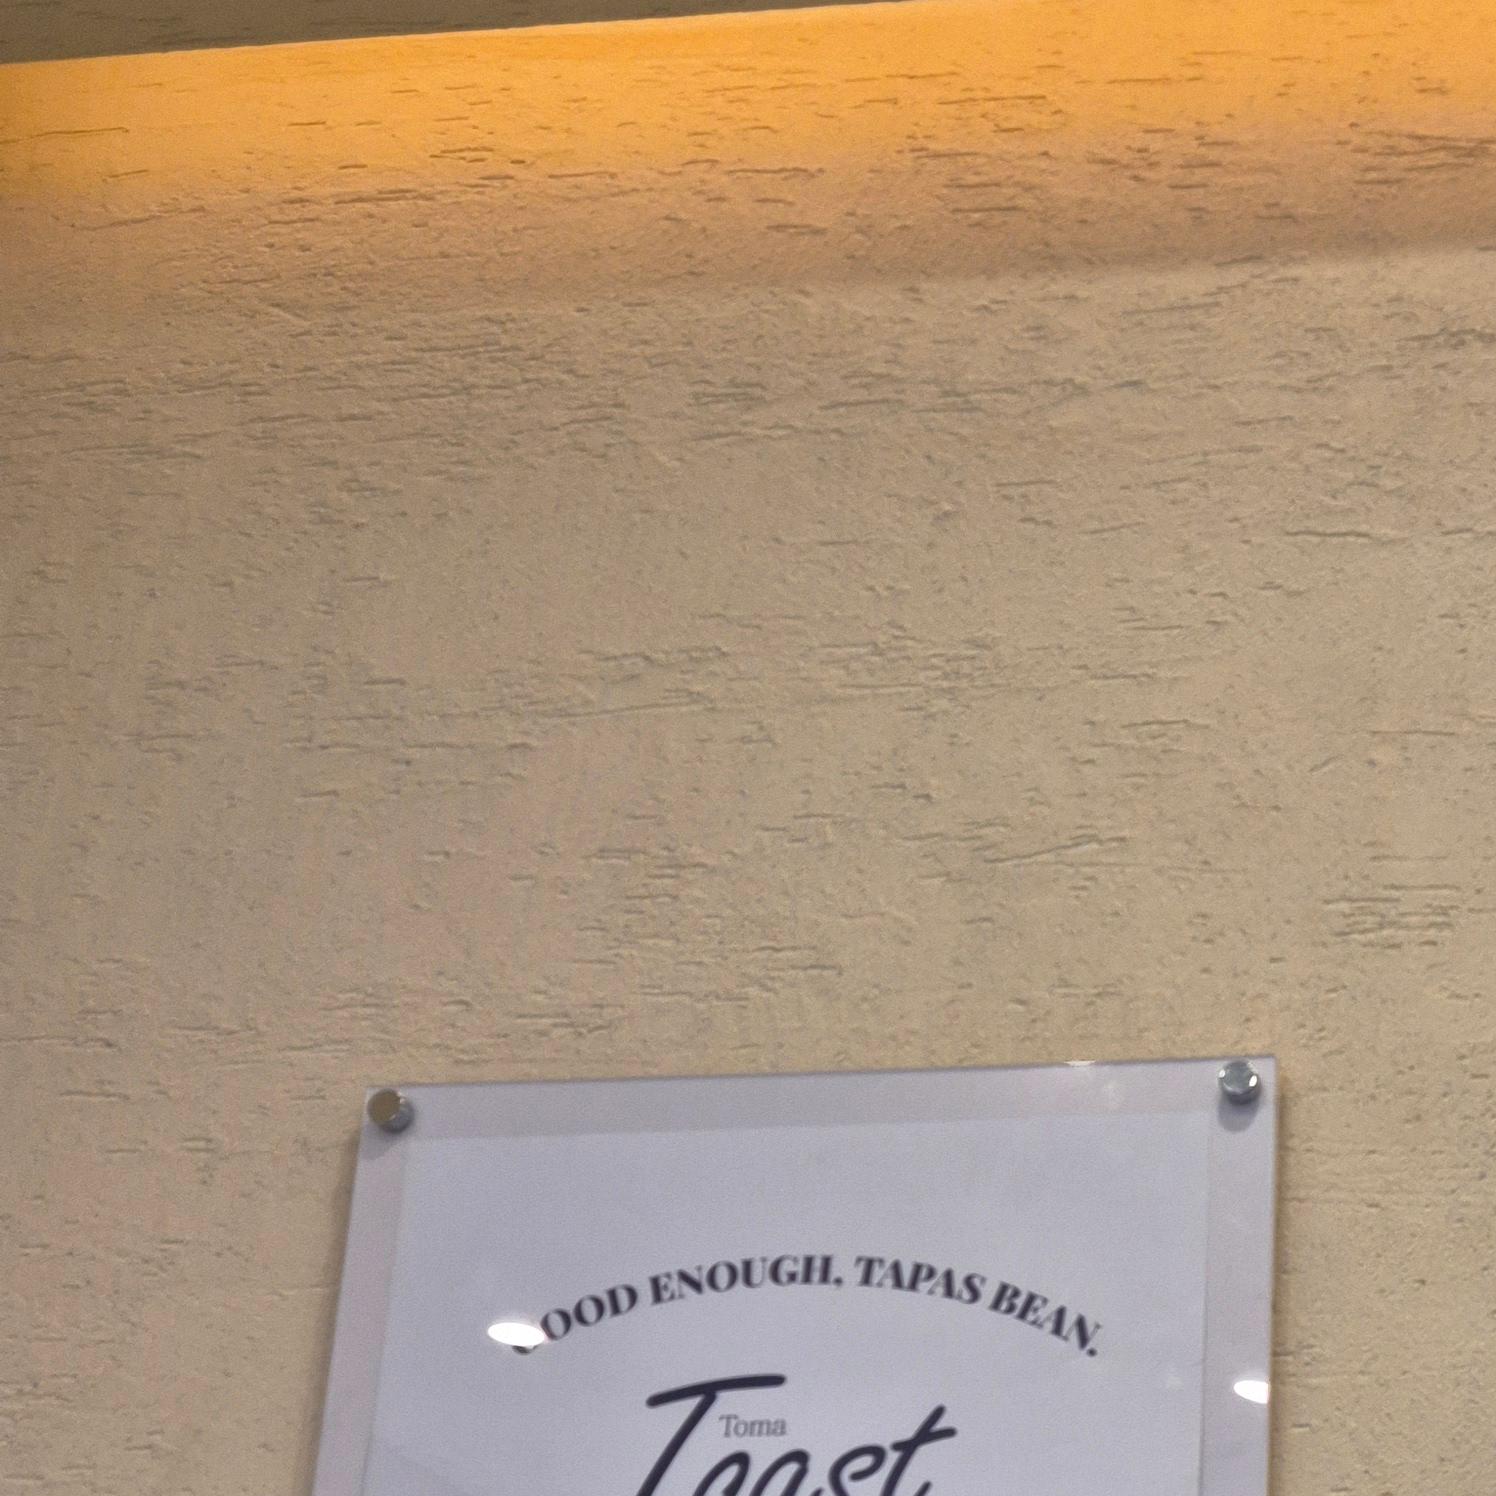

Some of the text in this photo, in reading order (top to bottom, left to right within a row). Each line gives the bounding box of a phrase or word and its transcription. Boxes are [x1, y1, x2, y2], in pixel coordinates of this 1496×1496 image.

[509, 1254, 1103, 1357] OOD ENOUGH, TAPAS BEAN.
[719, 1414, 787, 1438] Toma
